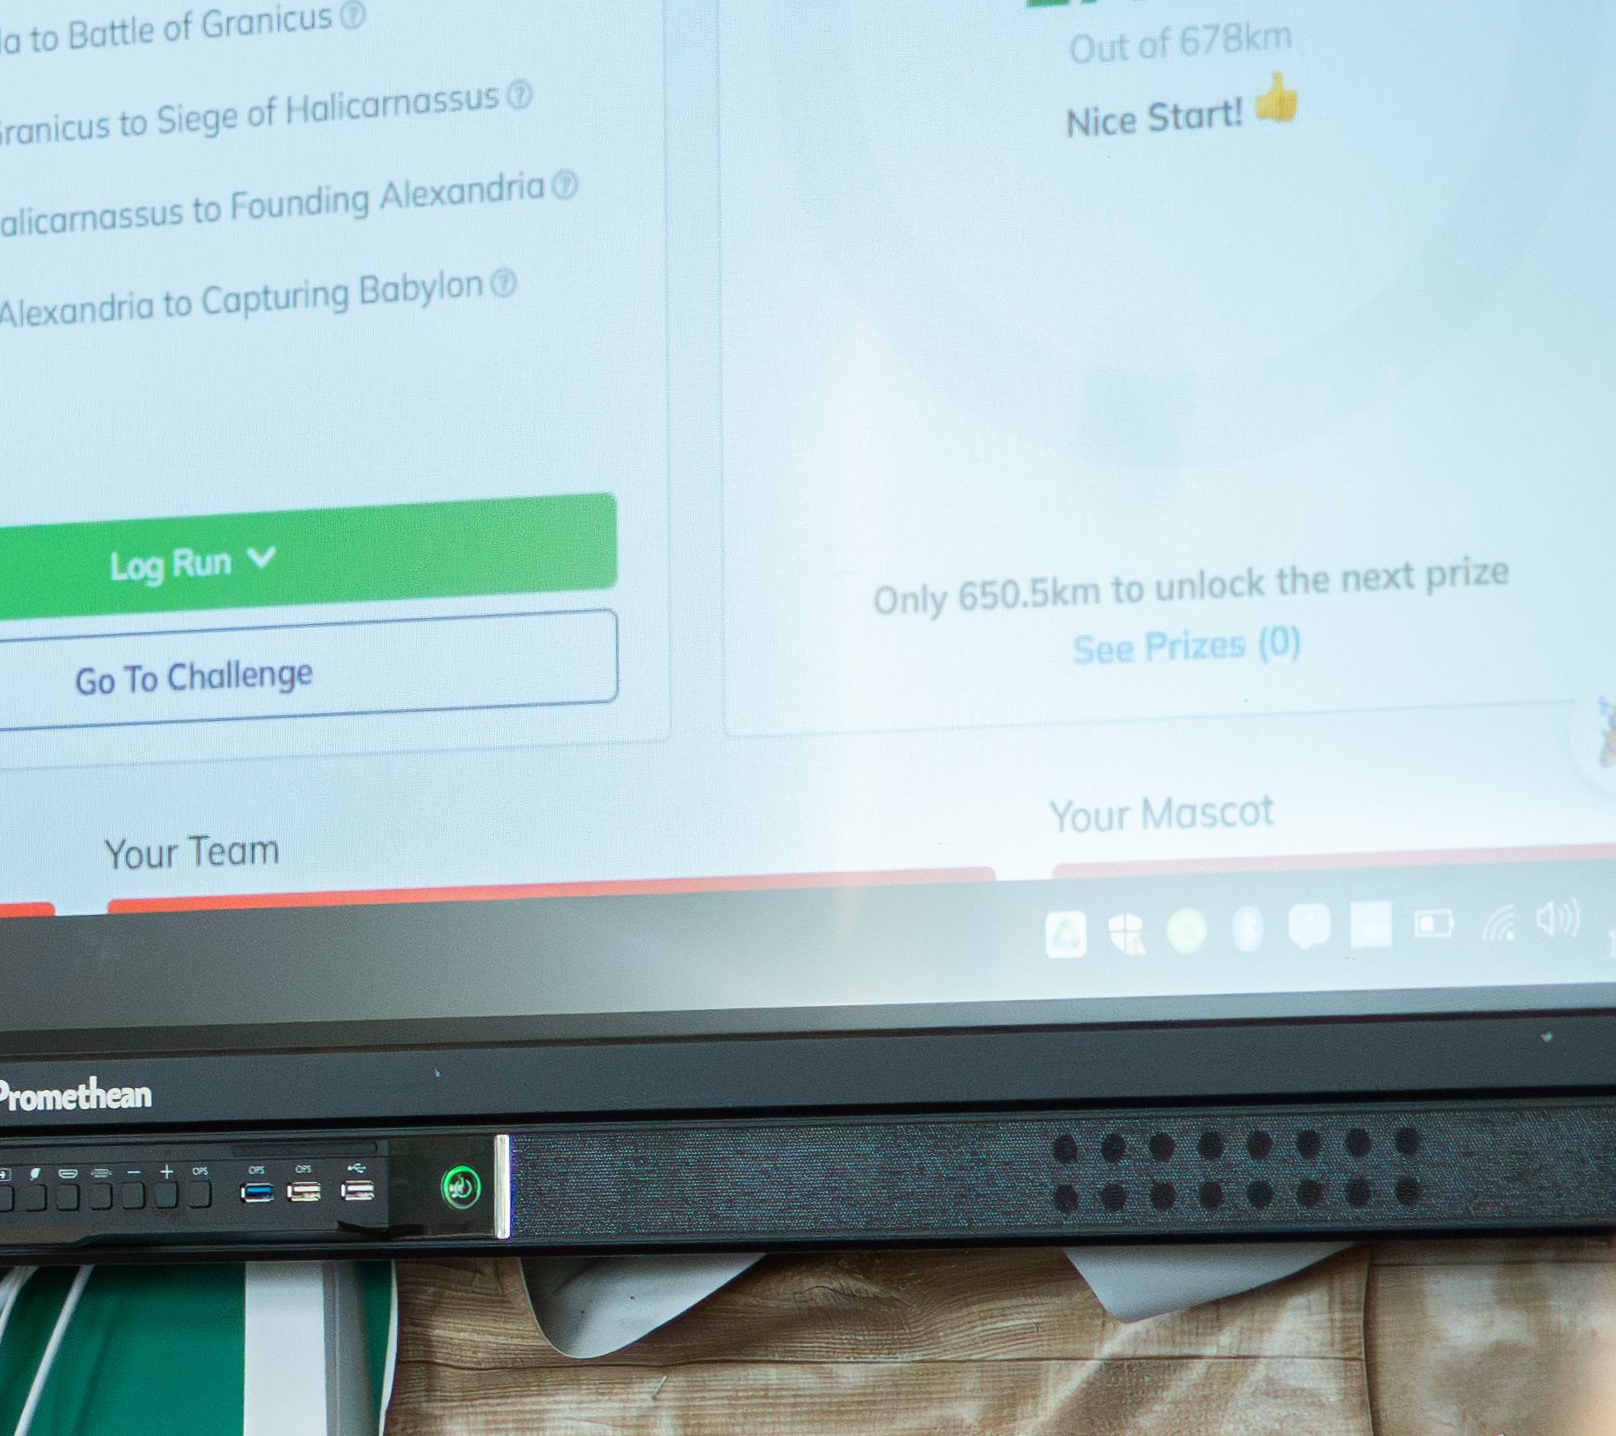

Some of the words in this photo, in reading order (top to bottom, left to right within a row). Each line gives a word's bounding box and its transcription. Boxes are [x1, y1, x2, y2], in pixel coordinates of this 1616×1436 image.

[28, 26, 60, 54] to
[68, 15, 155, 51] Battle
[162, 9, 193, 43] of
[201, 3, 333, 39] Granicus
[1068, 33, 1131, 65] Out
[1137, 25, 1172, 60] of
[1178, 20, 1293, 57] 678km
[118, 111, 149, 138] to
[156, 103, 239, 140] Siege
[246, 94, 278, 128] of
[285, 86, 500, 125] Halicarnassus
[1066, 106, 1138, 138] Nice
[1147, 96, 1243, 133] Start!
[191, 197, 222, 225] to
[230, 185, 370, 221] Founding
[379, 171, 545, 211] Alexandria
[161, 291, 193, 319] to
[201, 279, 350, 320] Capturing
[358, 269, 484, 310] Babylon
[110, 551, 166, 588] Log
[173, 547, 232, 577] Run
[873, 582, 949, 622] Only
[957, 575, 1101, 612] 650.5km
[1110, 576, 1145, 605] to
[1154, 565, 1266, 602] unlock
[1274, 564, 1331, 596] the
[1341, 561, 1416, 592] next
[1425, 554, 1510, 597] prize
[1073, 634, 1135, 666] See
[1145, 628, 1247, 662] Prizes
[1258, 624, 1303, 665] (0)
[75, 666, 116, 697] Go
[122, 663, 159, 694] To
[166, 659, 314, 695] Challenge
[1048, 799, 1132, 834] Your
[1141, 793, 1275, 830] Mascot
[103, 837, 180, 871] Your
[186, 833, 280, 868] Team
